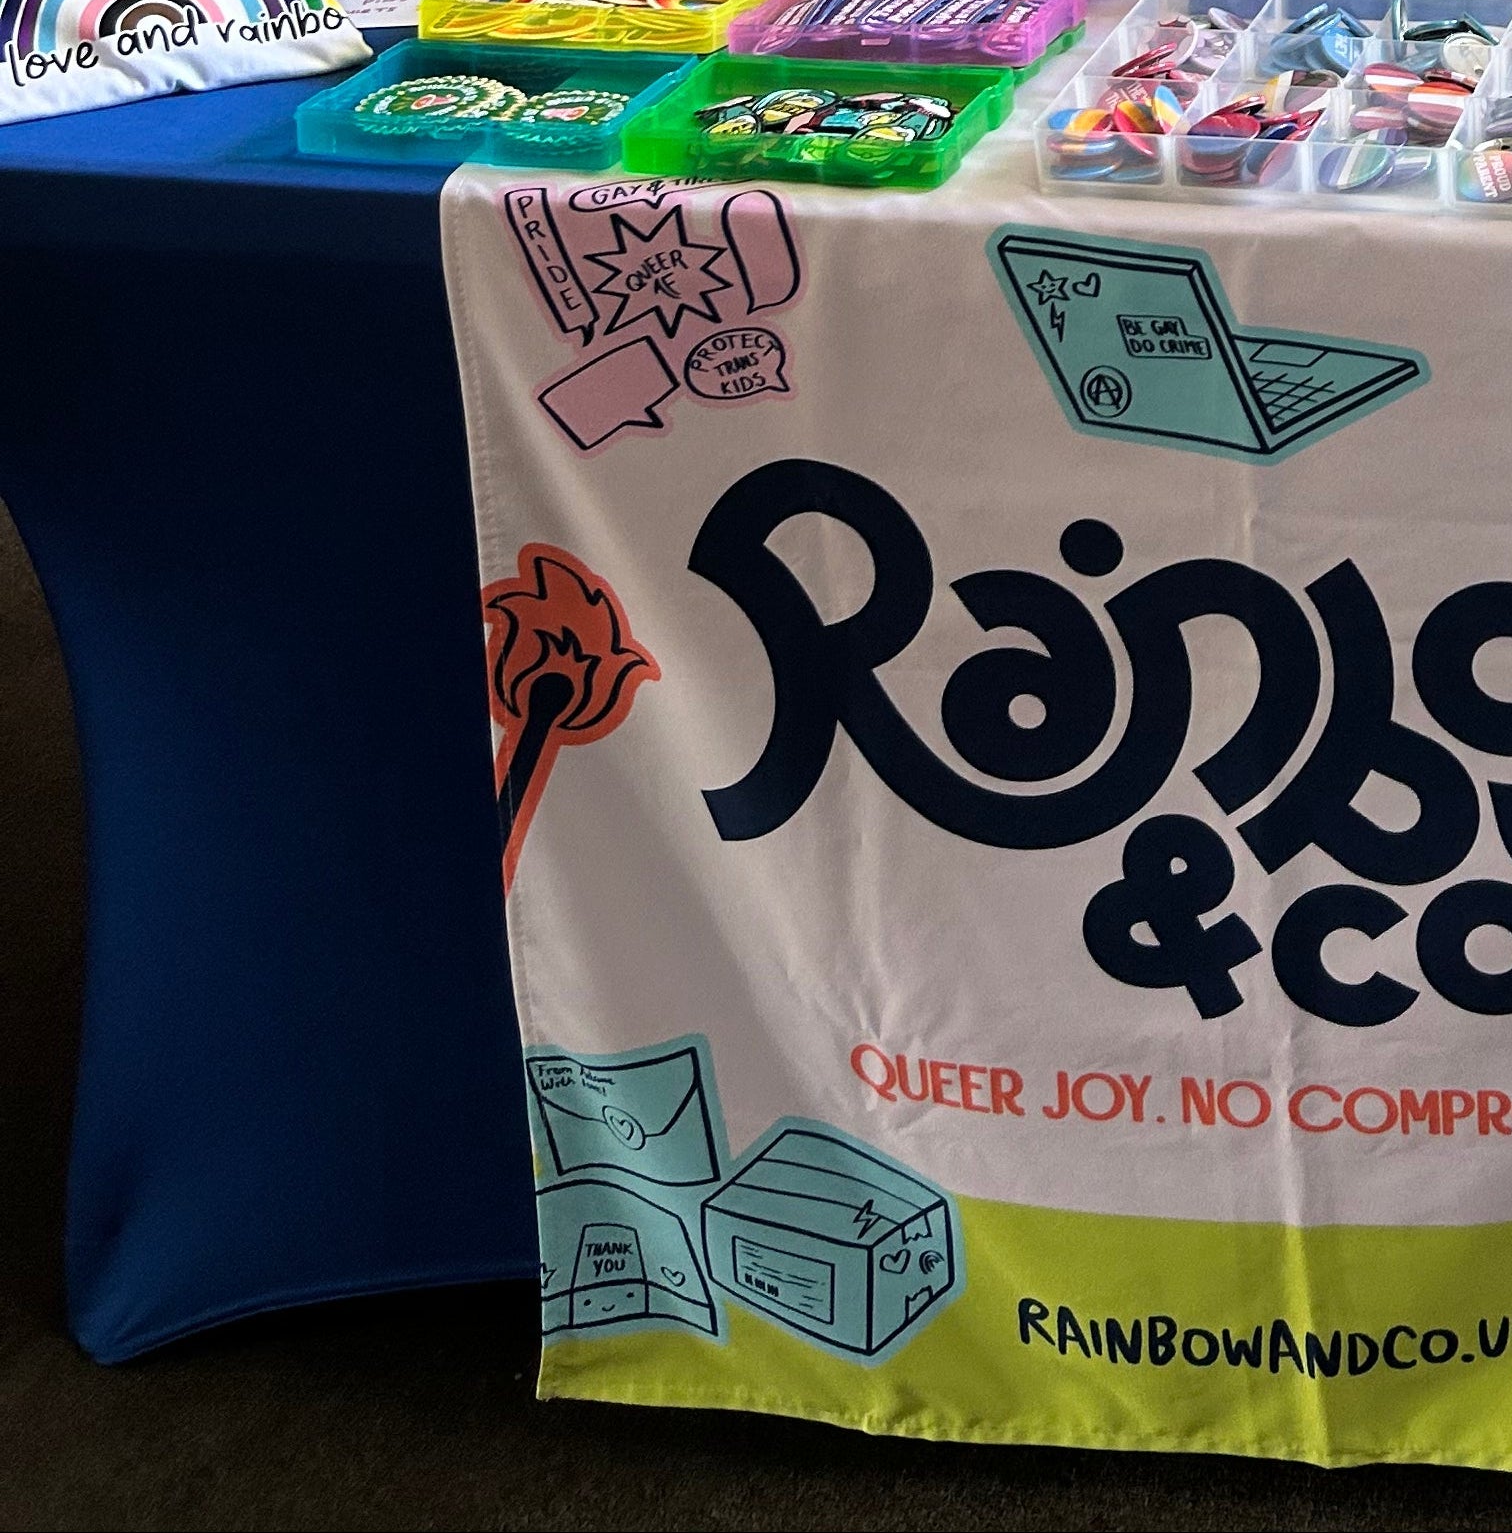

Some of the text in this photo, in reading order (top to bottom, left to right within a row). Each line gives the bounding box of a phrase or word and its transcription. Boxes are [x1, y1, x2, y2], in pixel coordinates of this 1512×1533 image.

[6, 3, 348, 87] love and rainbo
[592, 184, 639, 204] GAY
[626, 250, 688, 292] QUEER
[1151, 320, 1178, 336] GAY
[1129, 339, 1206, 355] DO CRIME
[714, 353, 758, 376] TRANS
[721, 373, 765, 394] KIDS
[851, 1042, 1028, 1120] QUEER
[1043, 1064, 1167, 1127] JOY.
[1180, 1077, 1271, 1128] NO
[586, 1242, 634, 1257] THANK
[594, 1259, 626, 1276] YOU
